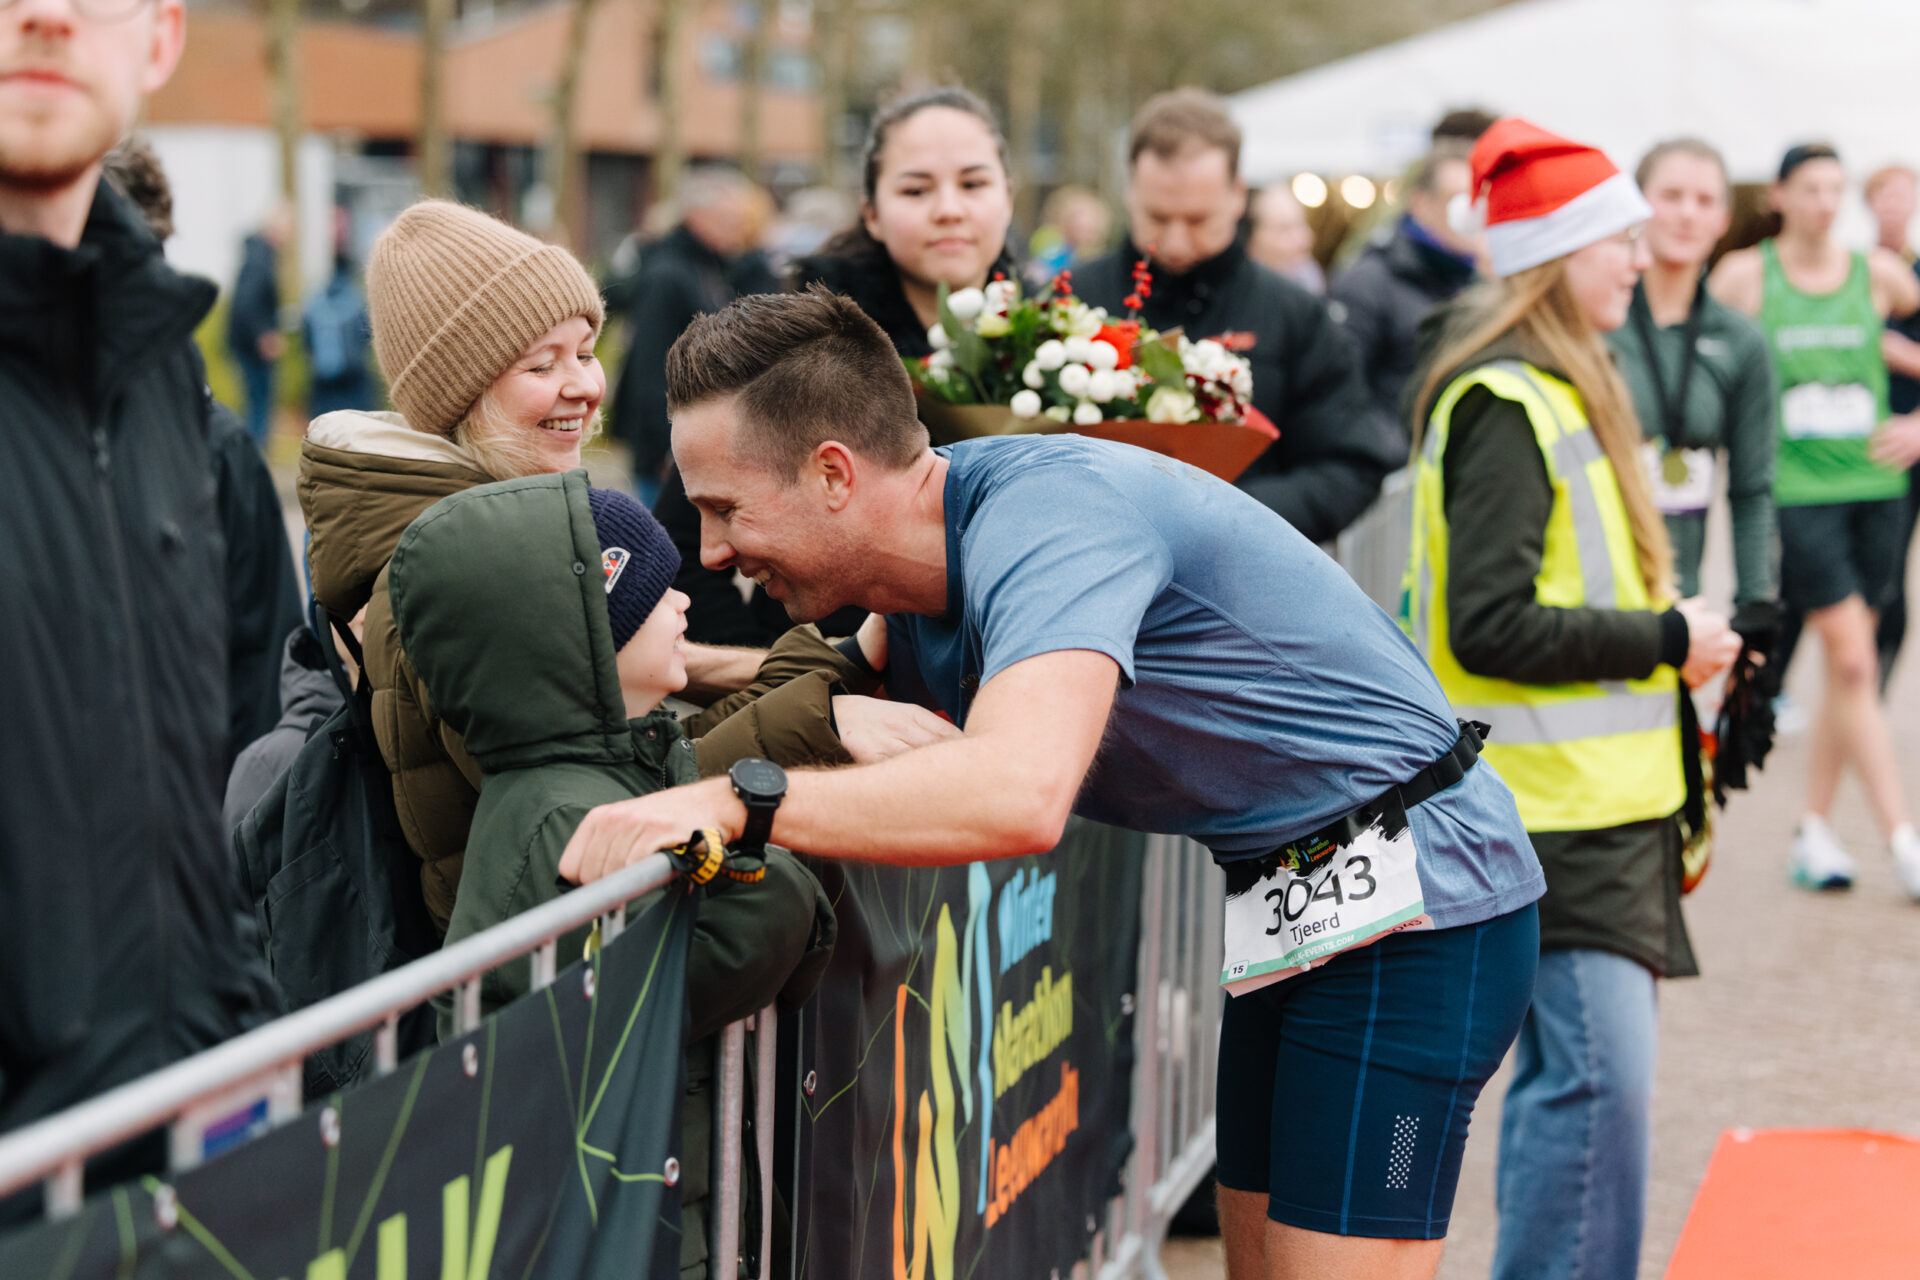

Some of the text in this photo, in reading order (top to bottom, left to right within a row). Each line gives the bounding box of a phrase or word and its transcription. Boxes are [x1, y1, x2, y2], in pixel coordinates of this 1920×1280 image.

[1265, 855, 1377, 935] 3043
[1290, 912, 1340, 945] Tjeerd
[1233, 965, 1244, 975] 15
